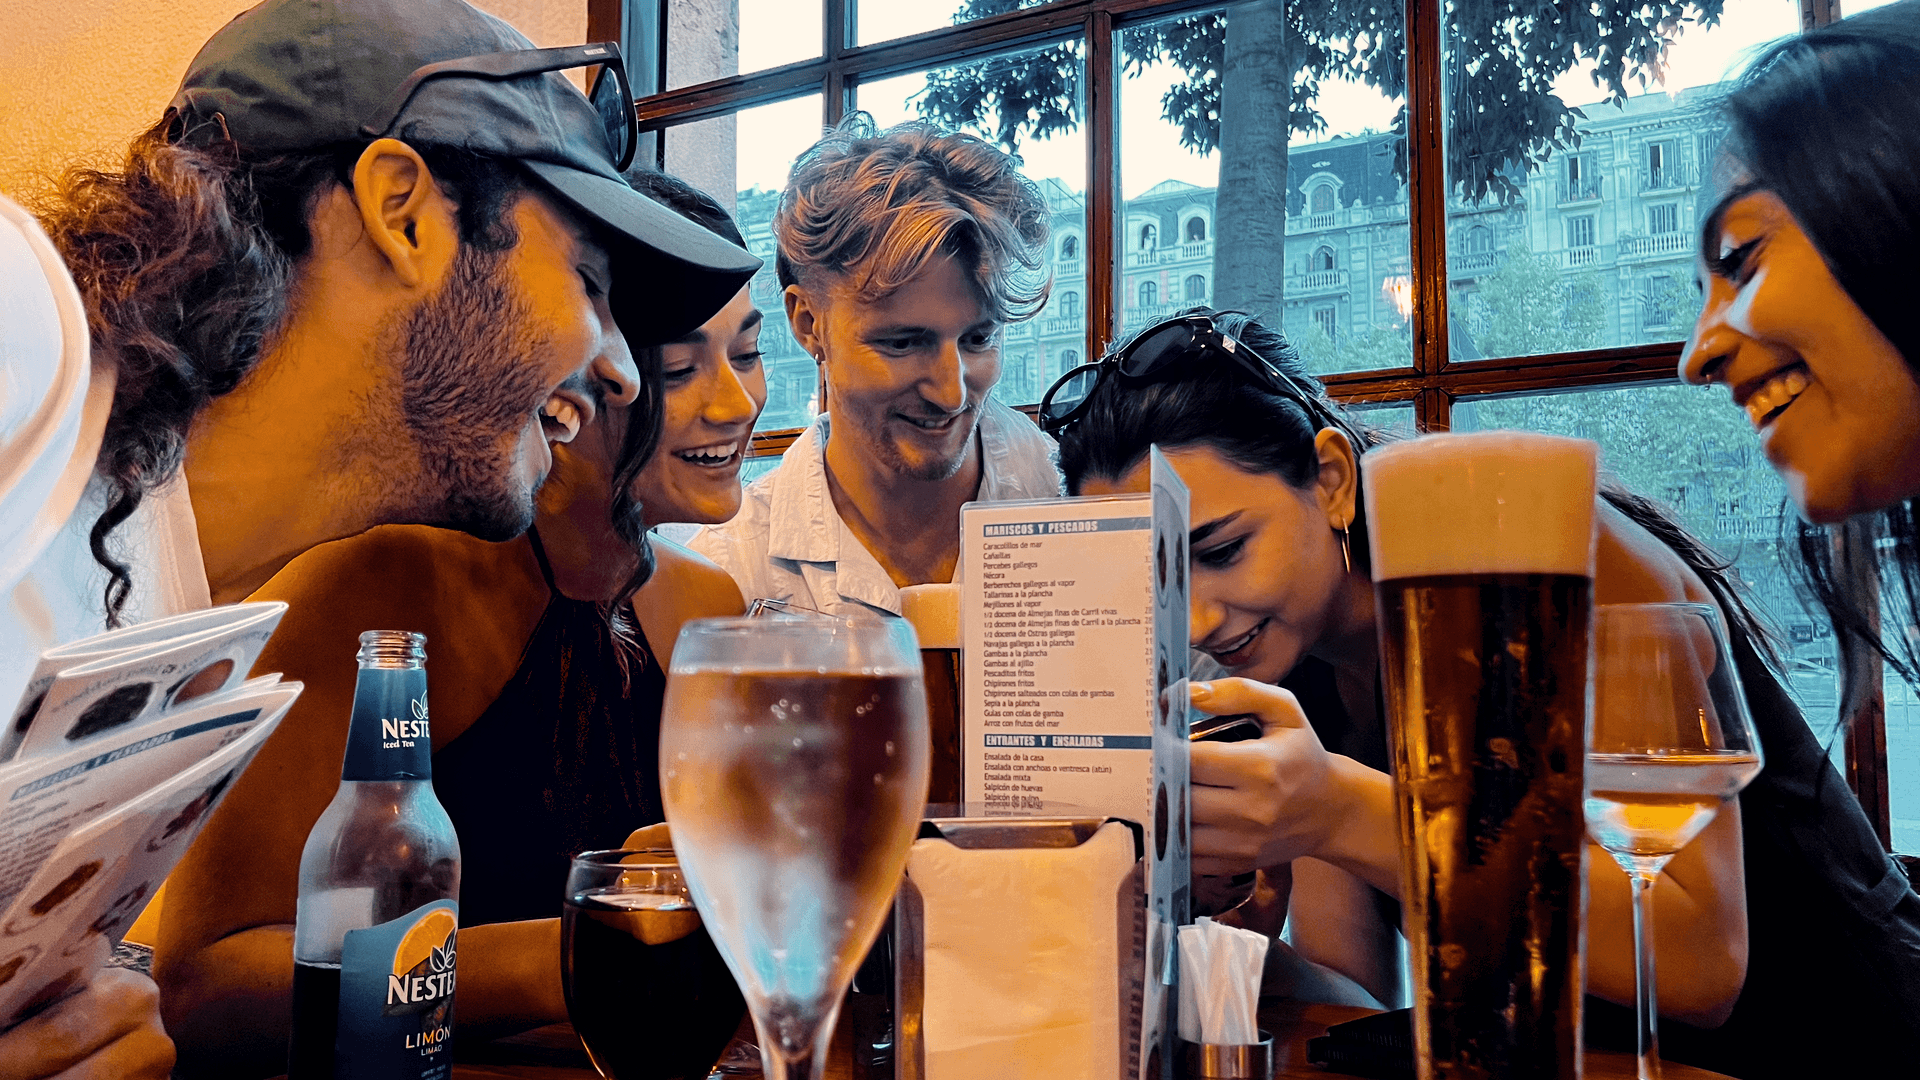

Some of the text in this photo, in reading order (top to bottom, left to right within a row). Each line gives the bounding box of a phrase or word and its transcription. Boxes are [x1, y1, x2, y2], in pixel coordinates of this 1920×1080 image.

[985, 521, 1098, 536] MARISCOS Y PESCADOS
[983, 562, 1037, 570] Percebes gallegos
[1023, 581, 1048, 589] gallegos
[1028, 610, 1053, 618] Almejas
[1028, 620, 1053, 628] Almejas
[1115, 618, 1140, 626] plancha
[1049, 630, 1075, 638] gallegas
[984, 641, 1008, 649] Navajas
[1009, 640, 1034, 649] gallegas
[1049, 640, 1074, 648] plancha
[1023, 650, 1047, 658] plancha
[1017, 660, 1034, 668] ajillo
[984, 680, 1016, 688] Chipirones
[1090, 690, 1114, 698] gambas
[1043, 710, 1063, 719] gamba
[383, 739, 415, 749] Iced Tea
[986, 735, 1104, 747] ENTRANTES Y ENSALADAS
[984, 773, 1011, 781] Ensalada
[984, 783, 1010, 791] Salpicón
[984, 793, 1010, 801] Salpicón
[405, 1024, 451, 1049] LIMÓN
